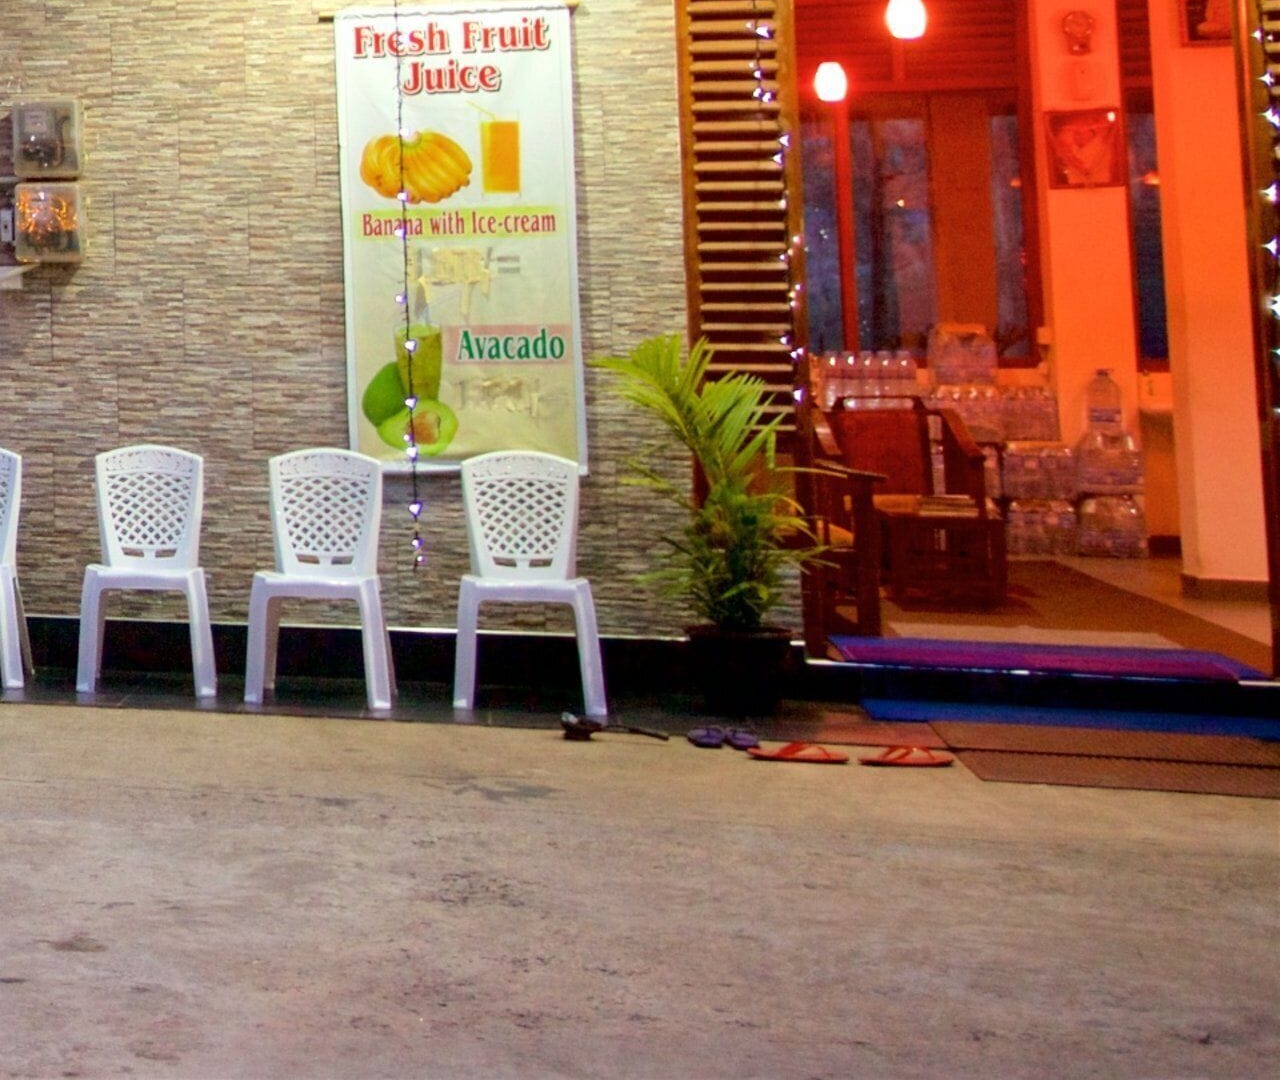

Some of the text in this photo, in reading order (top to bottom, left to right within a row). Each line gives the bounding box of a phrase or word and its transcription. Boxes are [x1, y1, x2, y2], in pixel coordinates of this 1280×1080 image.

[353, 17, 550, 58] Fresh Fruit
[401, 60, 502, 95] Juice
[362, 211, 557, 237] Banana with Ice-cream
[458, 328, 565, 360] Avacado
